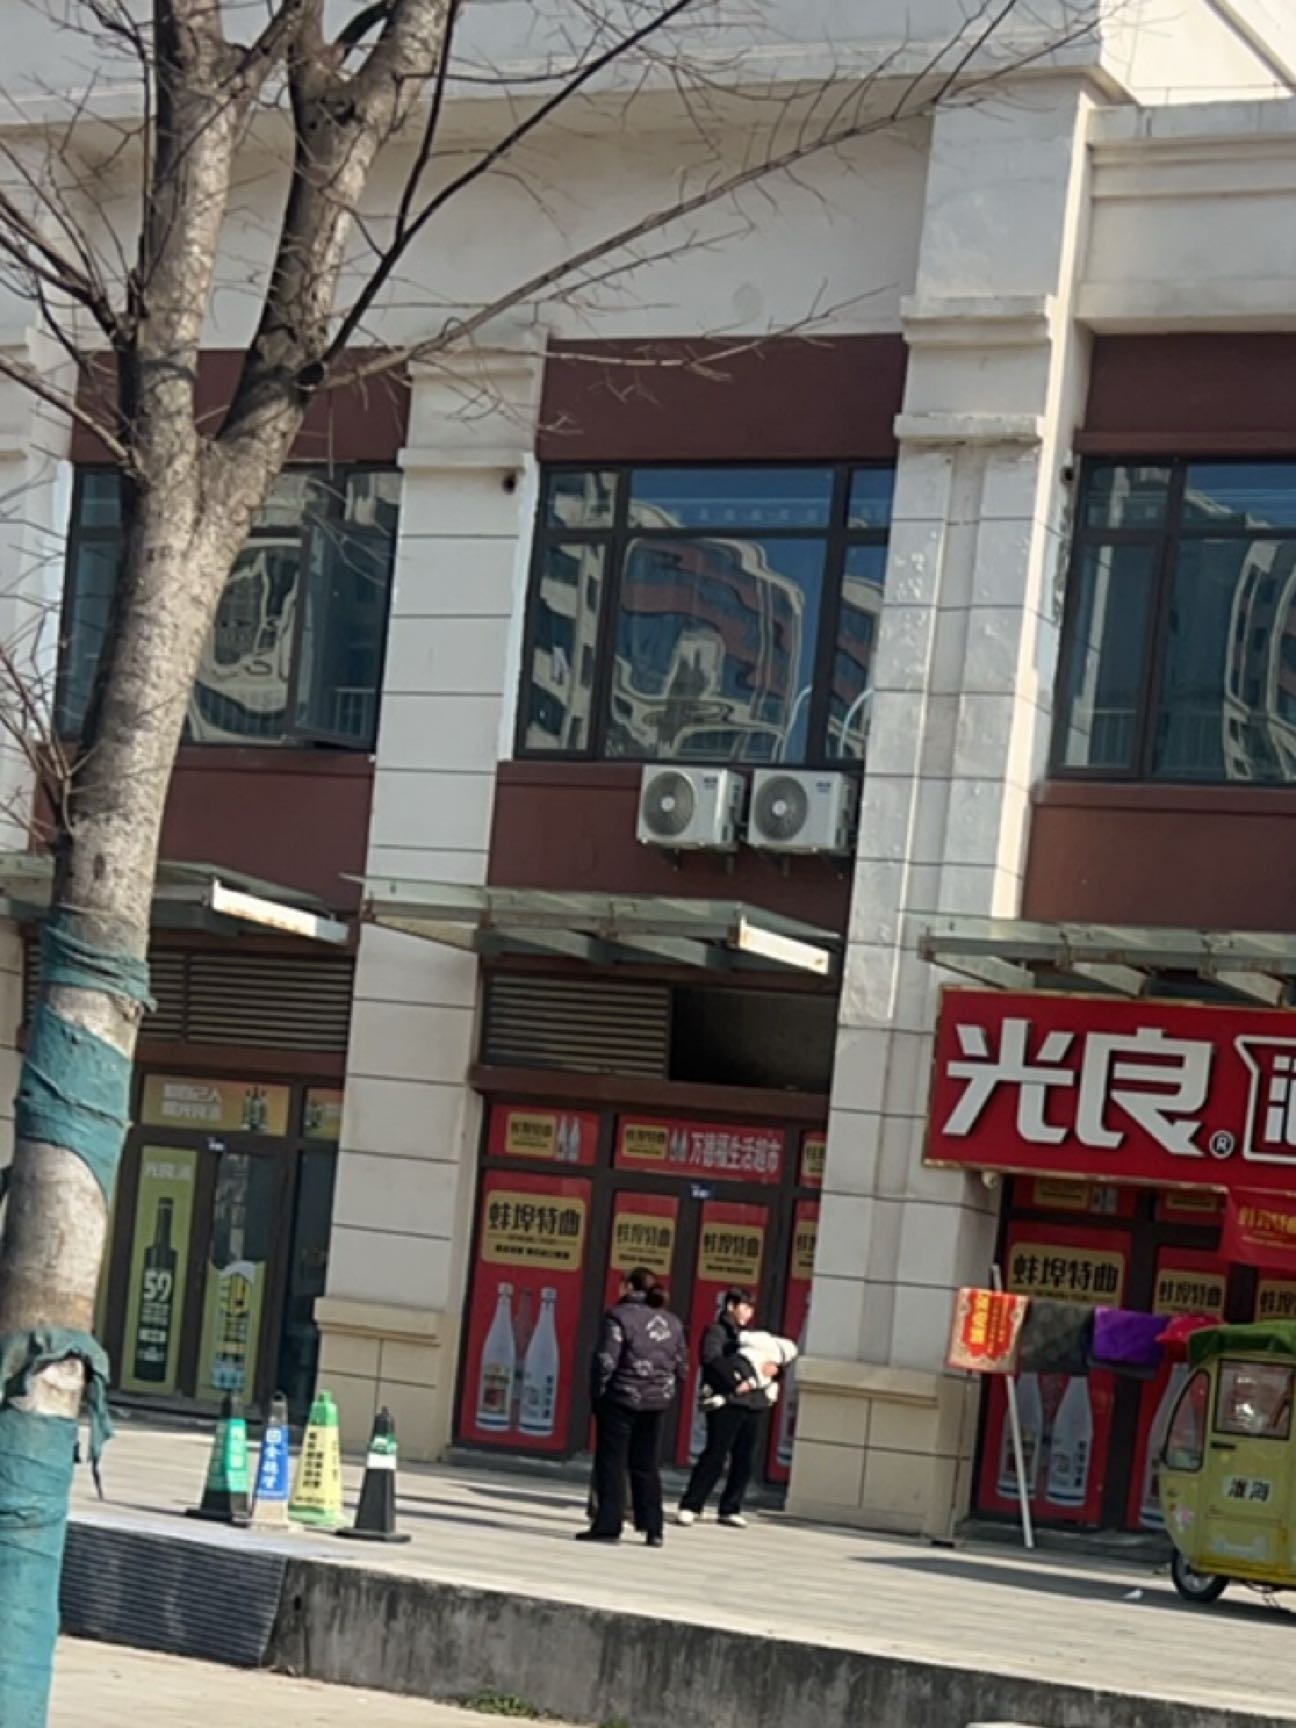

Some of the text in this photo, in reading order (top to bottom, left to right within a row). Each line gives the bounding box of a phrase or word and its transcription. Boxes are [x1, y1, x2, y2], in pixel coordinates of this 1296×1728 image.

[942, 1017, 1213, 1157] 光良
[1013, 1254, 1119, 1292] 蚌埠特曲
